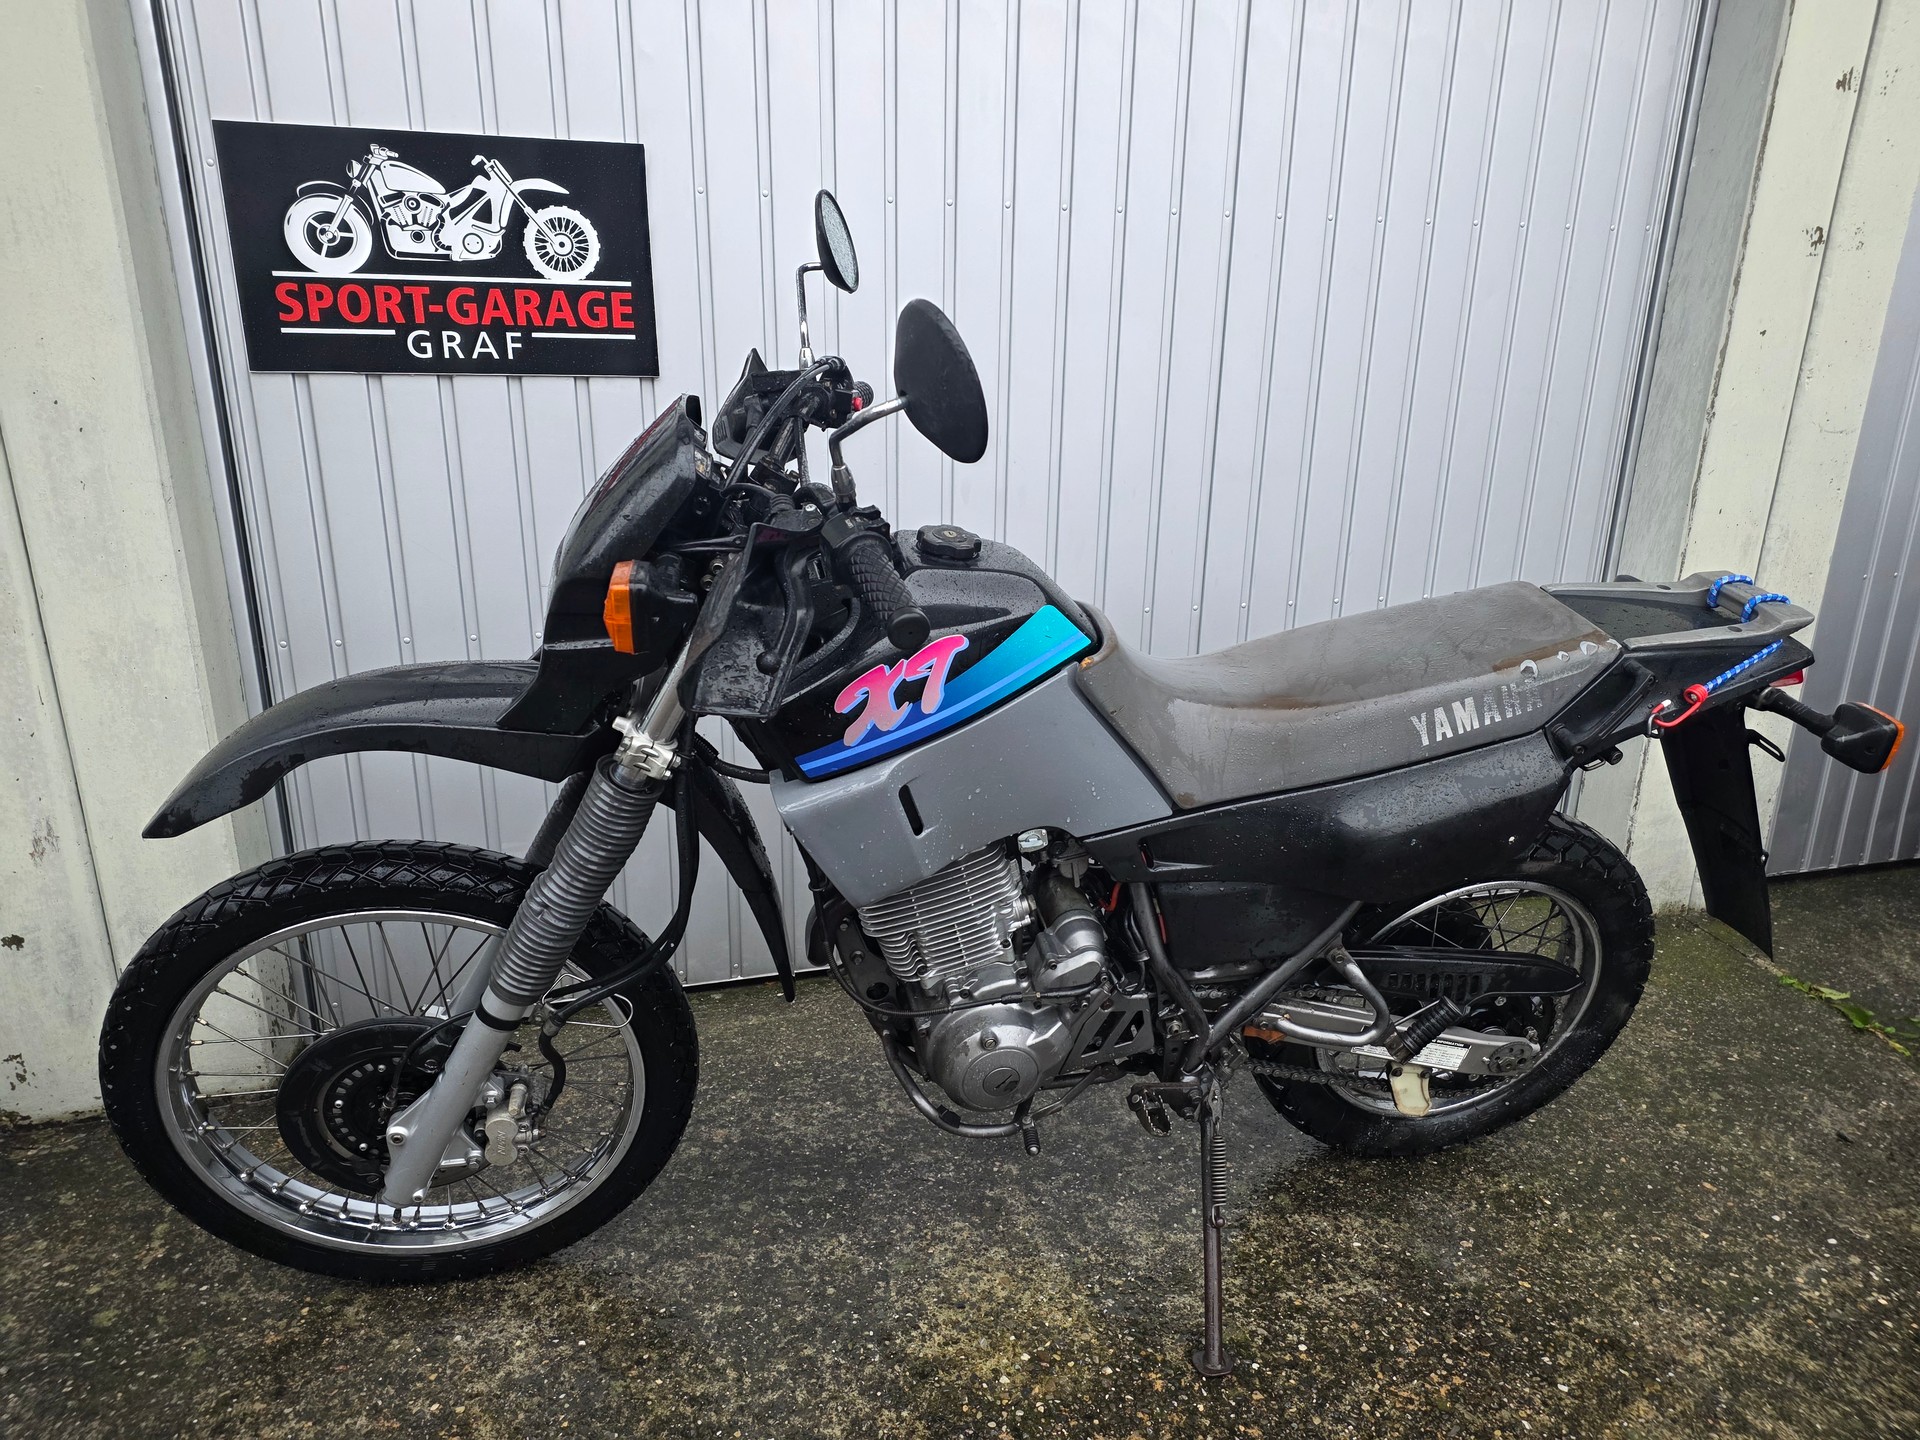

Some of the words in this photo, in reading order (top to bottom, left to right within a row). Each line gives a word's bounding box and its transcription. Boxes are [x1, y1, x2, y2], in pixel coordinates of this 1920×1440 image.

[274, 282, 636, 329] SPORT-GARAGE
[406, 330, 523, 360] GRAF
[834, 634, 970, 746] XT
